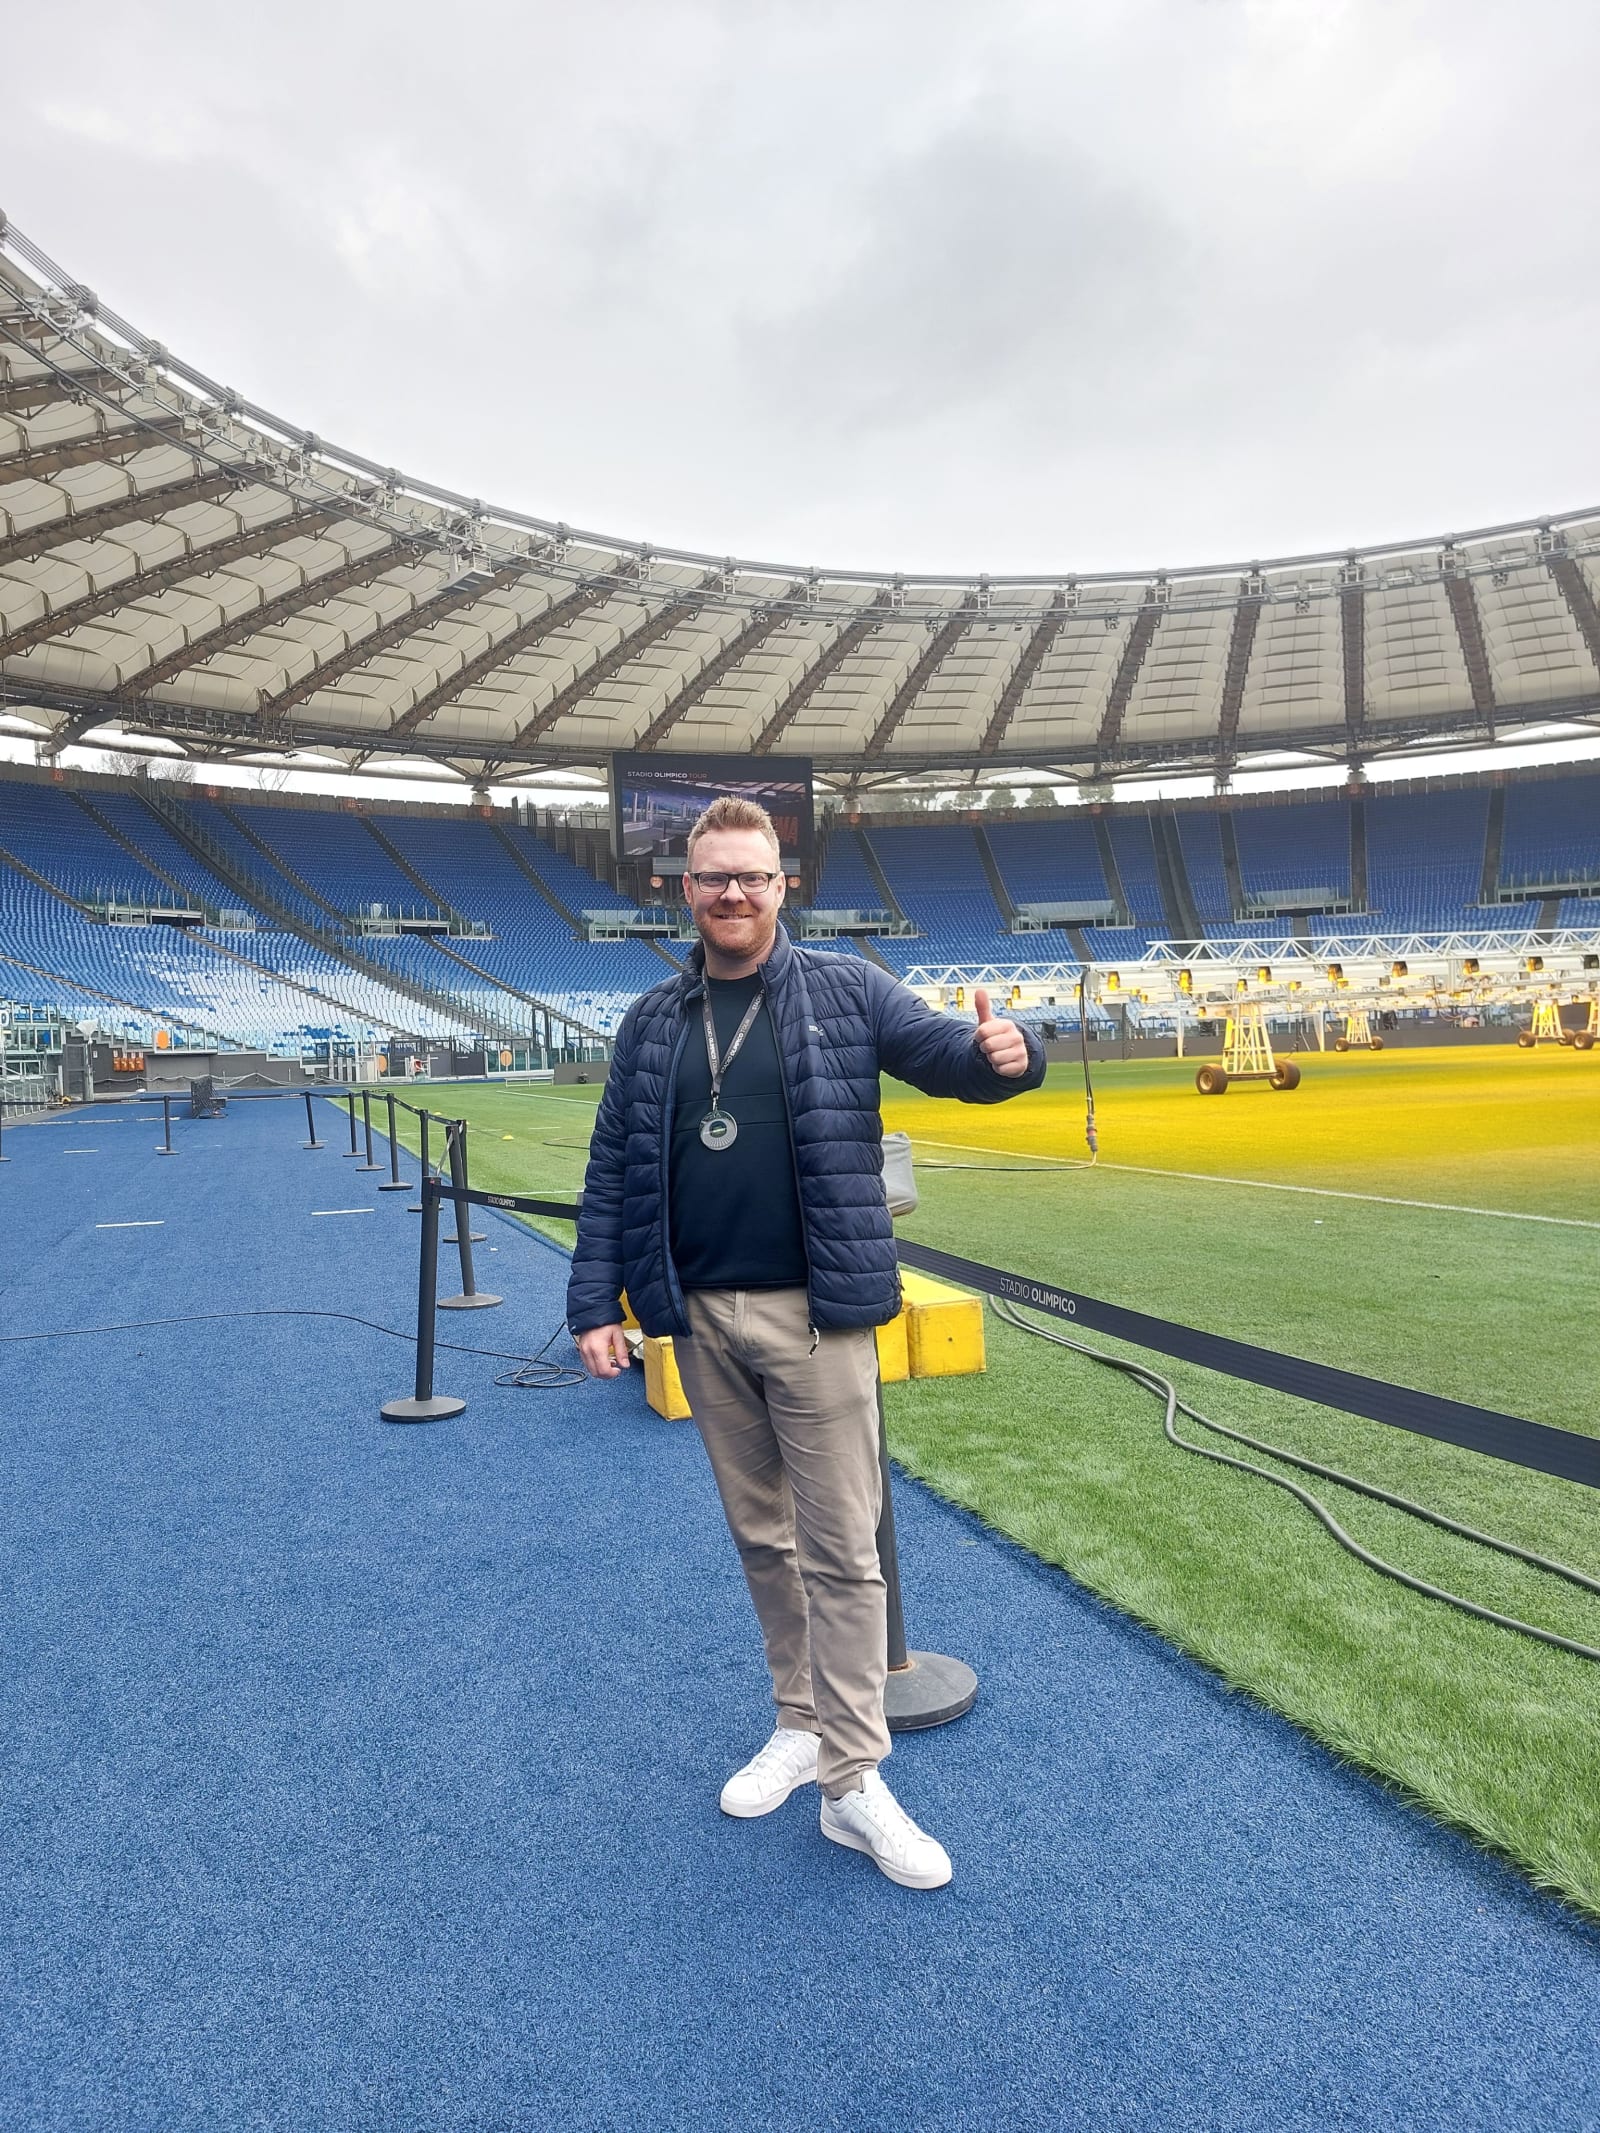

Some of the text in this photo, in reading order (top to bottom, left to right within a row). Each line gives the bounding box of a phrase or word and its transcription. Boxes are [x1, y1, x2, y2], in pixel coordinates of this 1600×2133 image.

[654, 771, 688, 779] OLIMPICO
[729, 1032, 744, 1056] OLIMPICO
[1000, 1277, 1076, 1315] STADIO OLIMPICO
